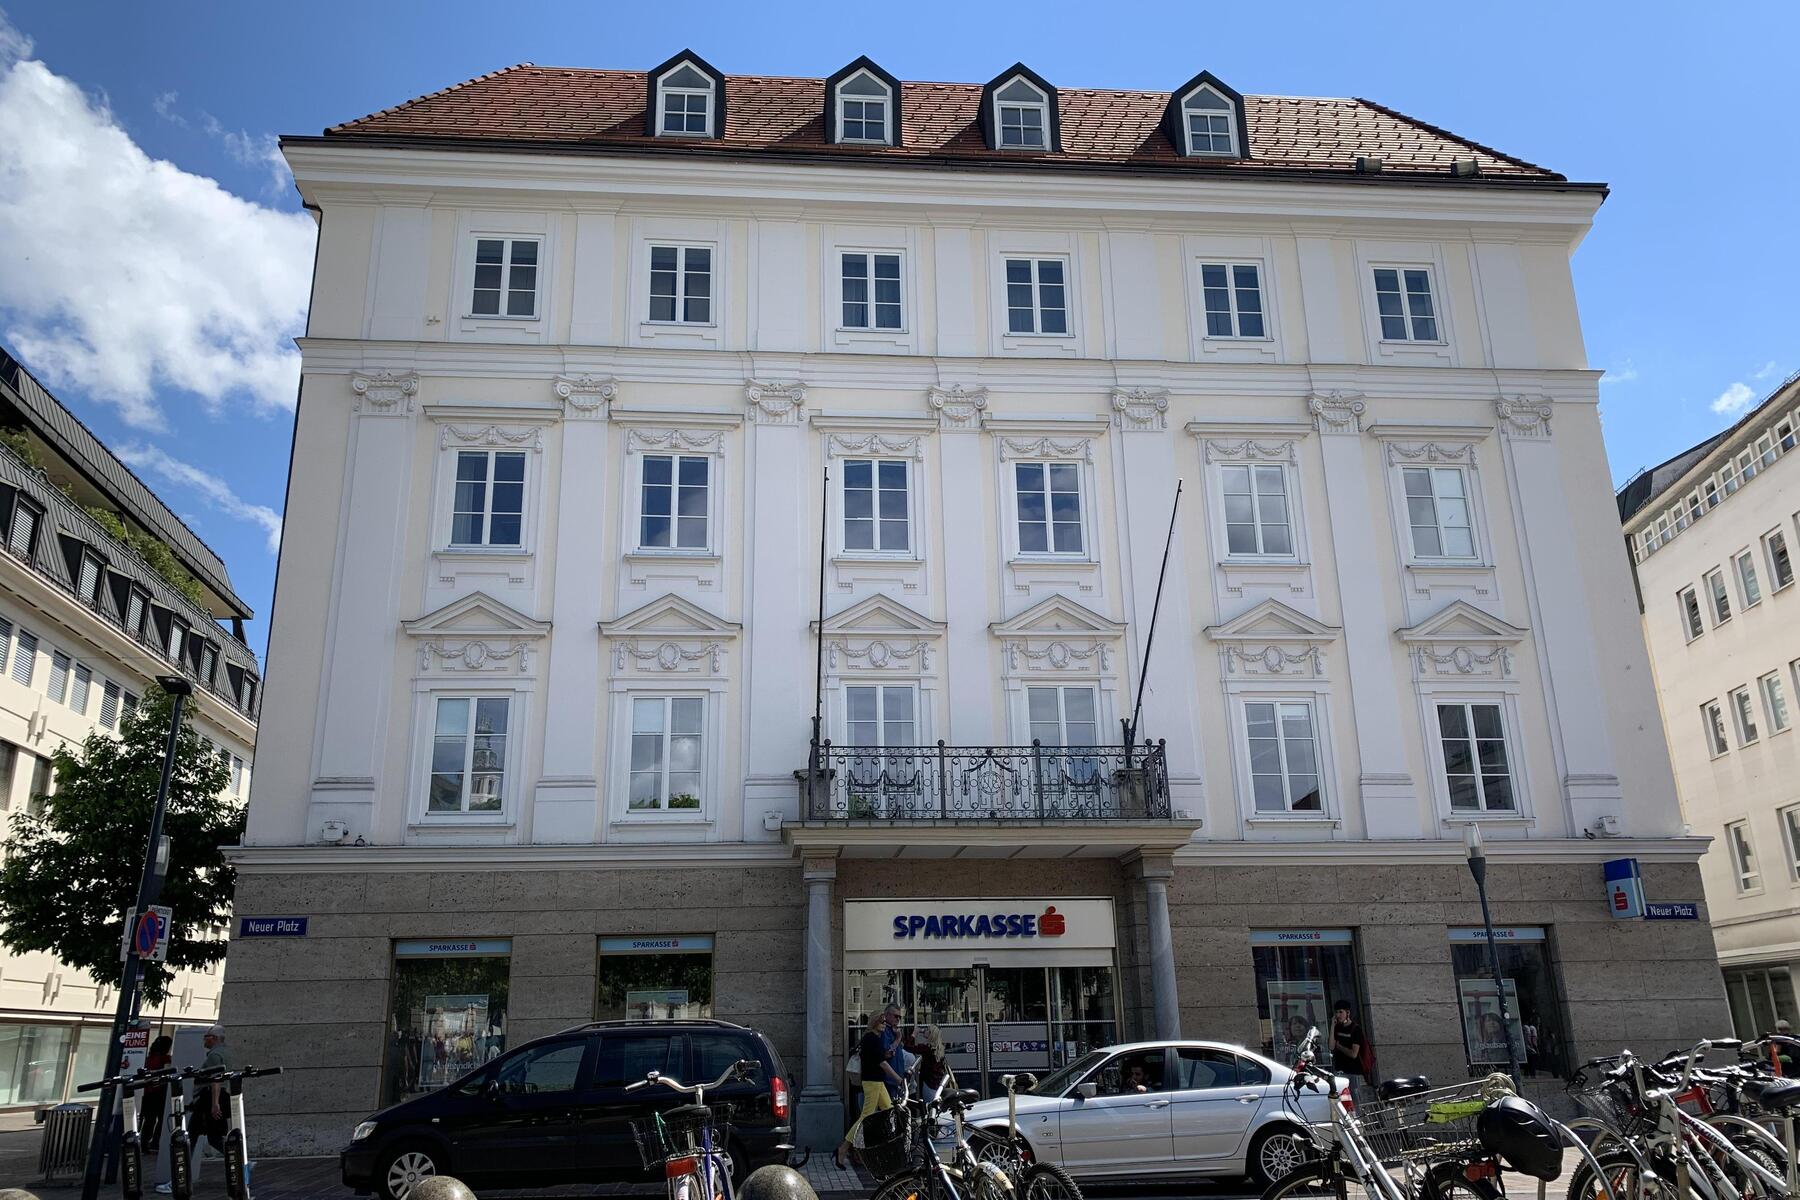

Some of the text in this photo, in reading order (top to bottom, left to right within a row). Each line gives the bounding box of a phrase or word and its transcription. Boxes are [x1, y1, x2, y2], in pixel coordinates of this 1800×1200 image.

[1650, 905, 1693, 916] Neuer Platz
[248, 920, 300, 932] Neuer Platz
[893, 914, 1037, 938] SPARKASSE
[429, 944, 468, 952] SPARKASSE
[126, 1031, 147, 1039] EINE
[124, 1039, 146, 1047] TUNG
